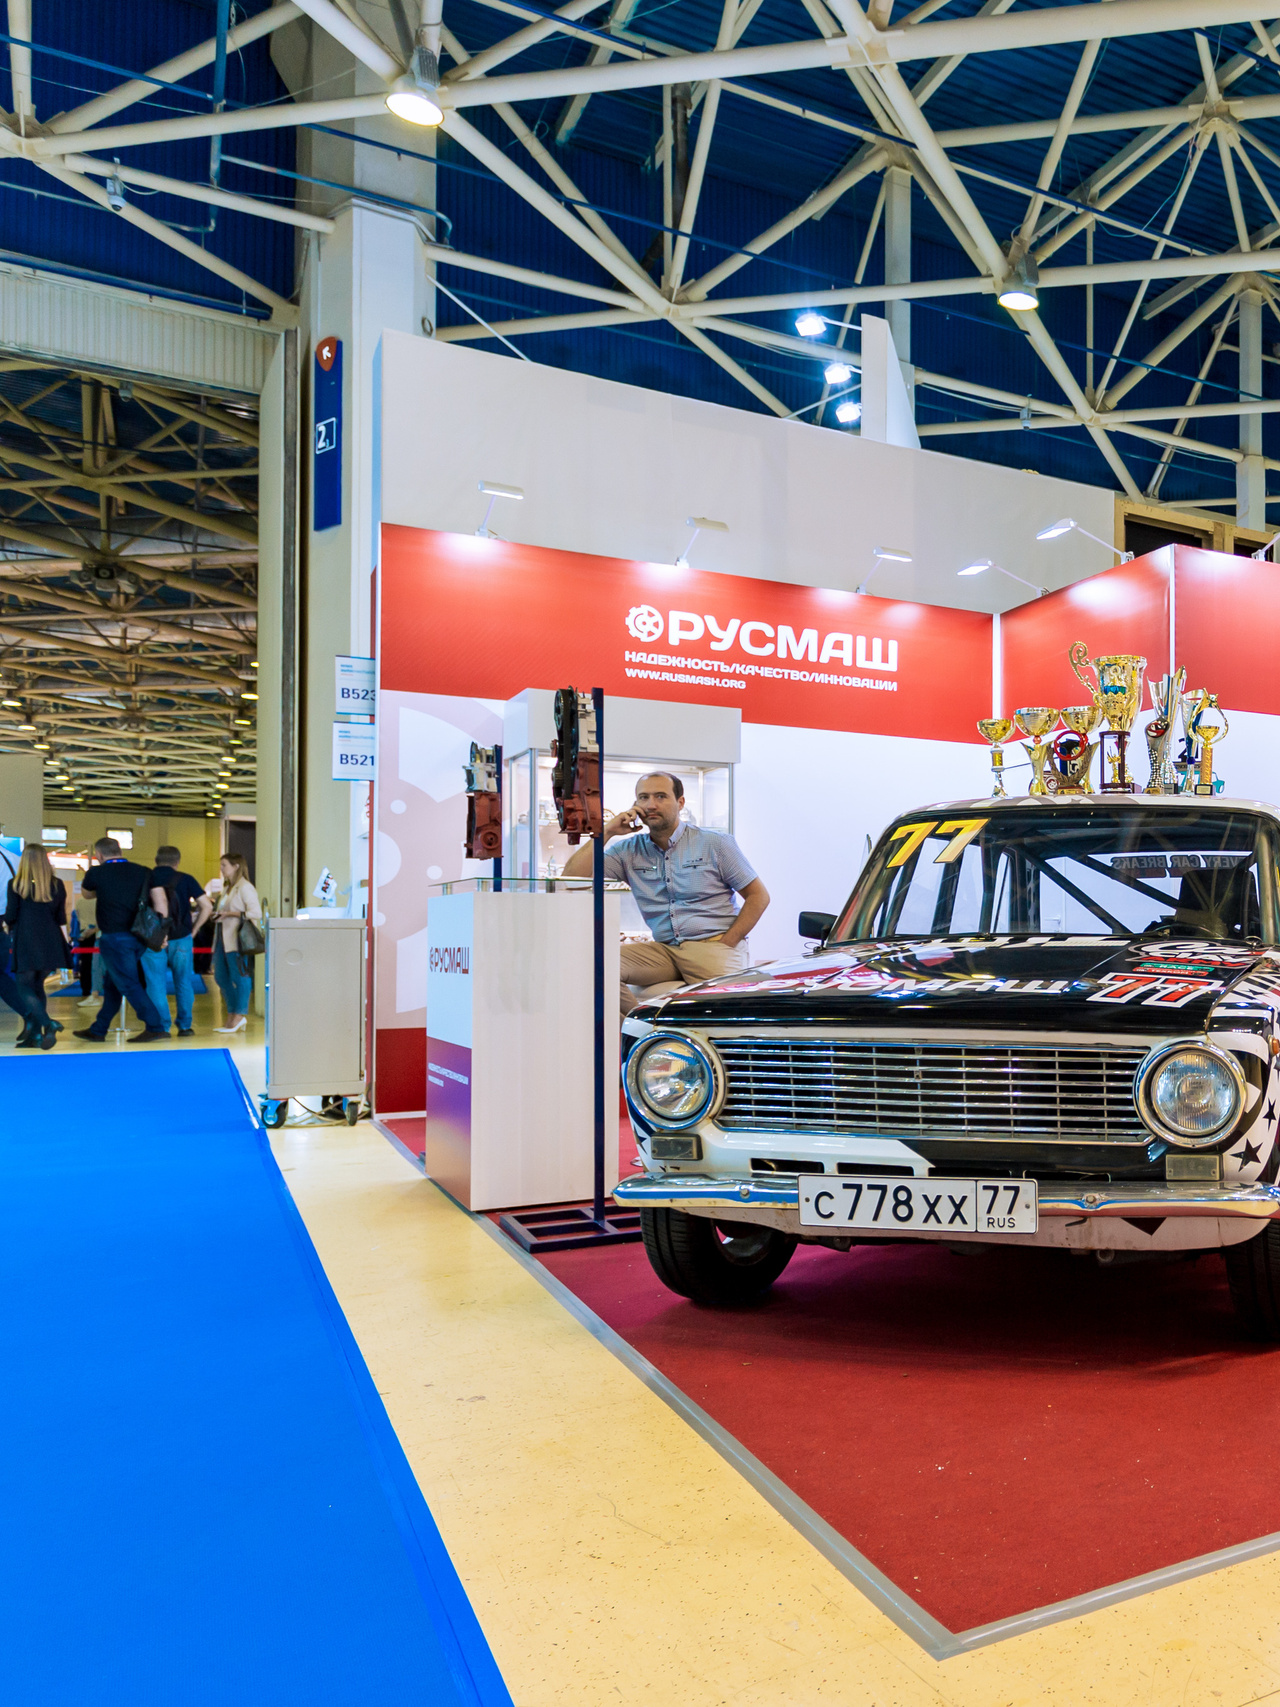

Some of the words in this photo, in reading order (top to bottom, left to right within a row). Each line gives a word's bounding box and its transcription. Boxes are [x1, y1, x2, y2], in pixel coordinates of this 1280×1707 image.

[668, 610, 898, 672] РУСМАШ
[625, 650, 898, 692] НАДЕЖНОСТЬ/КАЧЕСТВО/ИННОВАЦИИ
[625, 667, 746, 689] WWW.RUSMASH.ORG
[340, 753, 375, 767] B521
[886, 818, 990, 869] 77
[434, 947, 469, 974] РУСМАШ
[1086, 972, 1225, 1009] 77
[982, 1185, 1020, 1215] 77
[987, 1217, 1016, 1228] RUS
